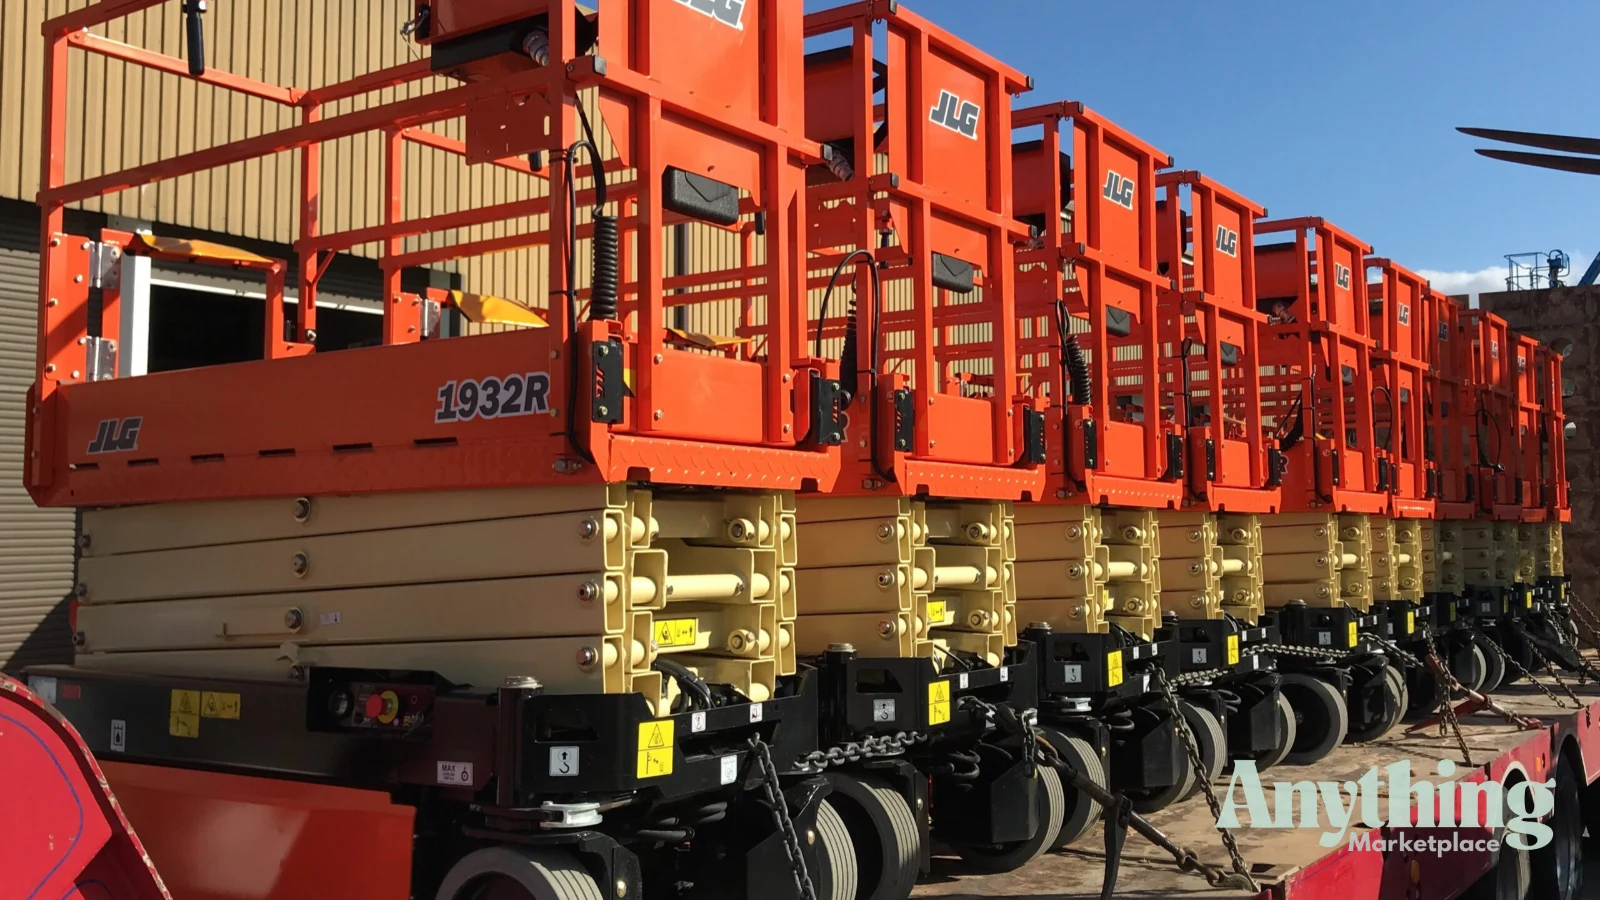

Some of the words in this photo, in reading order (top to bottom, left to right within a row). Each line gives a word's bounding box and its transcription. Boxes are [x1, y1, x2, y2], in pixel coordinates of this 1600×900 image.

[929, 89, 980, 140] JLG
[1103, 169, 1135, 211] JLG
[435, 371, 550, 424] 1932R
[86, 416, 143, 455] JLG
[441, 763, 456, 772] MAX
